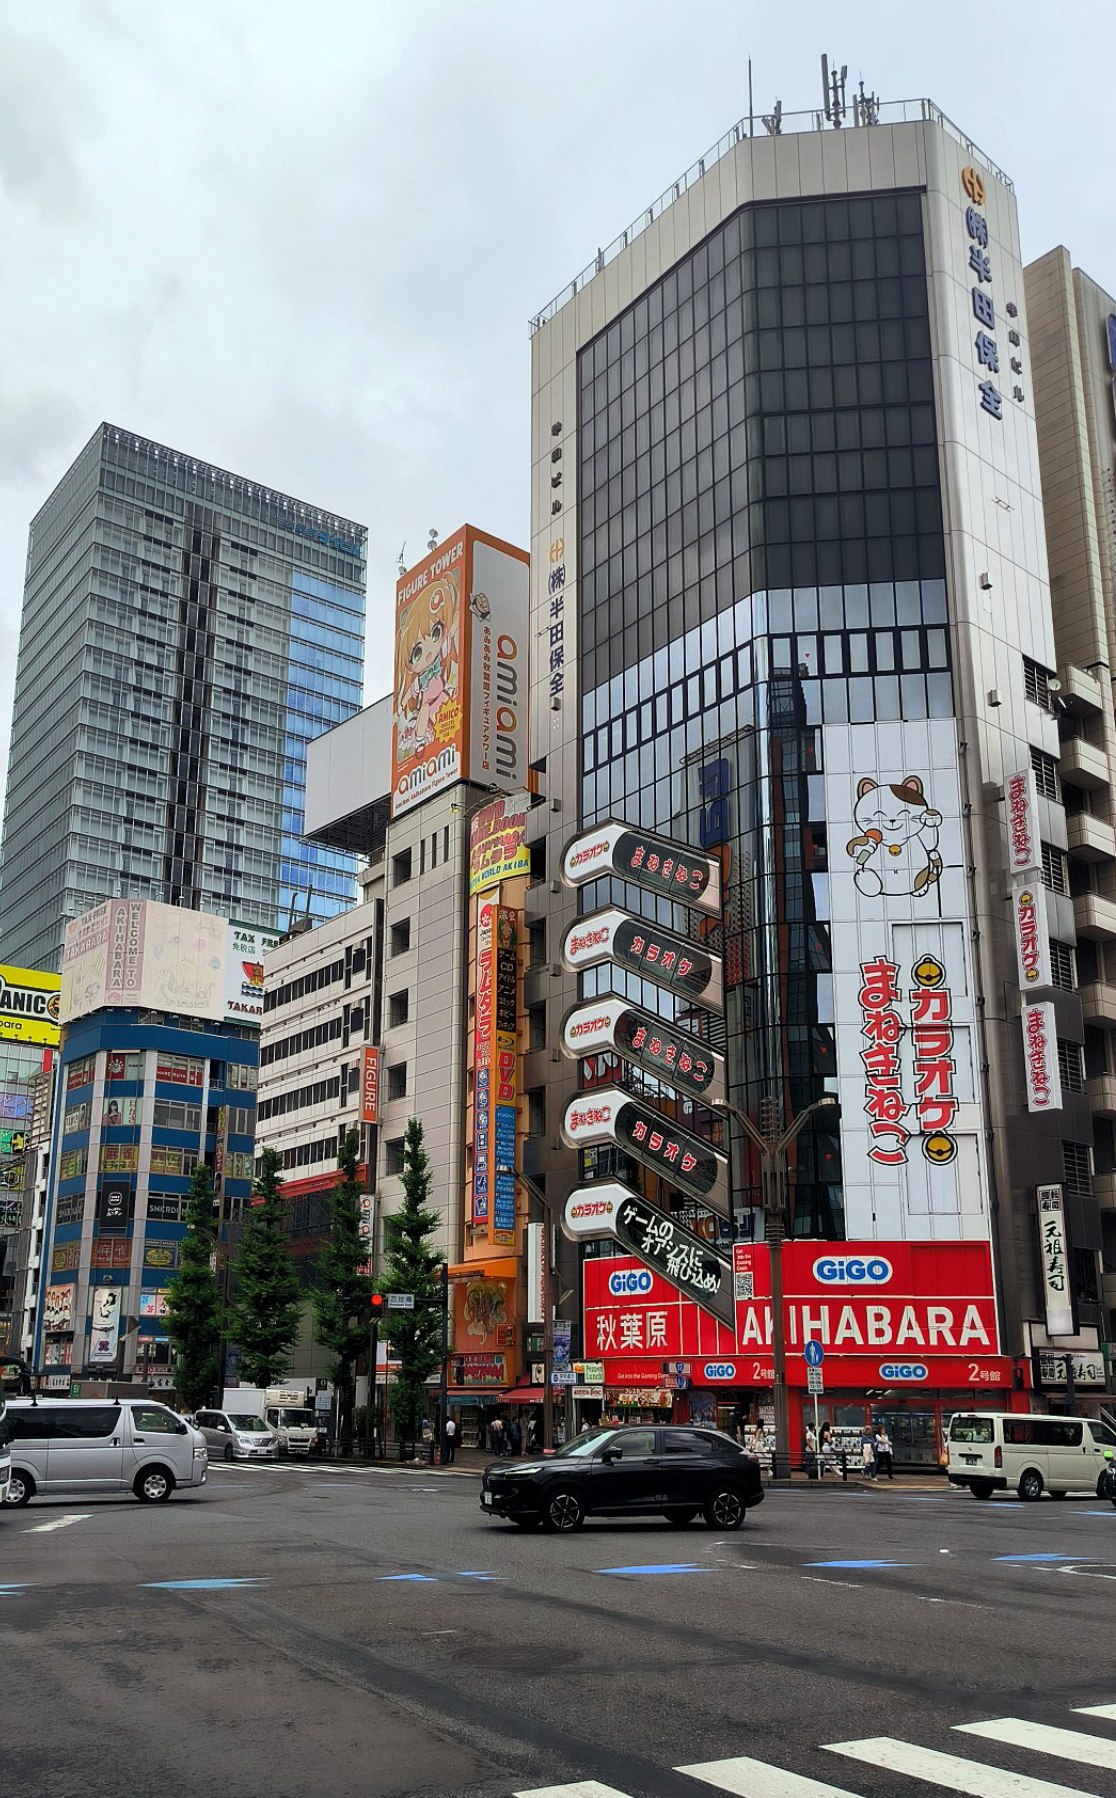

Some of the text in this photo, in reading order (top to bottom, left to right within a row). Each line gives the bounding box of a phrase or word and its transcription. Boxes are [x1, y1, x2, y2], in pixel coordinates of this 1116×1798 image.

[398, 541, 463, 606] FIGURE TOWER
[496, 634, 518, 780] amiami
[399, 744, 456, 795] amiami
[1008, 775, 1032, 867] まねきねこ
[503, 860, 529, 873] AKIBA
[575, 842, 605, 864] カラオケ
[630, 844, 704, 889] まねきねこ
[112, 908, 126, 987] AKIHABARA
[128, 903, 141, 965] WELCOME
[232, 942, 256, 955] 免税店
[234, 931, 279, 948] TAX FRE
[570, 927, 610, 956] まねきねこ
[1018, 905, 1038, 970] カラオケ
[500, 961, 514, 973] CD
[632, 936, 693, 976] カラオケ
[127, 969, 136, 987] TO
[0, 989, 46, 1015] ANIC
[227, 1000, 263, 1016] TAKAR
[575, 1018, 606, 1036] カラオケ
[632, 1027, 708, 1082] まねきねこ
[858, 956, 911, 1166] まねきねこ
[911, 988, 958, 1134] カラオケ
[1026, 1008, 1051, 1107] まねきねこ
[365, 1057, 376, 1111] FIGURE
[498, 1051, 515, 1101] DVD
[570, 1105, 611, 1132] まねきねこ
[632, 1121, 697, 1172] カラオケ
[576, 1202, 607, 1218] カラオケ
[623, 1205, 674, 1241] ゲームの
[641, 1233, 704, 1268] オアシスに
[1044, 1220, 1065, 1292] 元祖寿司
[610, 1272, 651, 1292] GiGO
[666, 1259, 721, 1294] 飛び込め!
[816, 1260, 889, 1281] GiGO
[597, 1311, 668, 1351] 秋葉原
[641, 1372, 657, 1381] Gaming
[705, 1365, 734, 1377] GiGO
[753, 1362, 775, 1380] 2号館
[880, 1364, 926, 1380] GiGO
[968, 1363, 1001, 1382] 2号館
